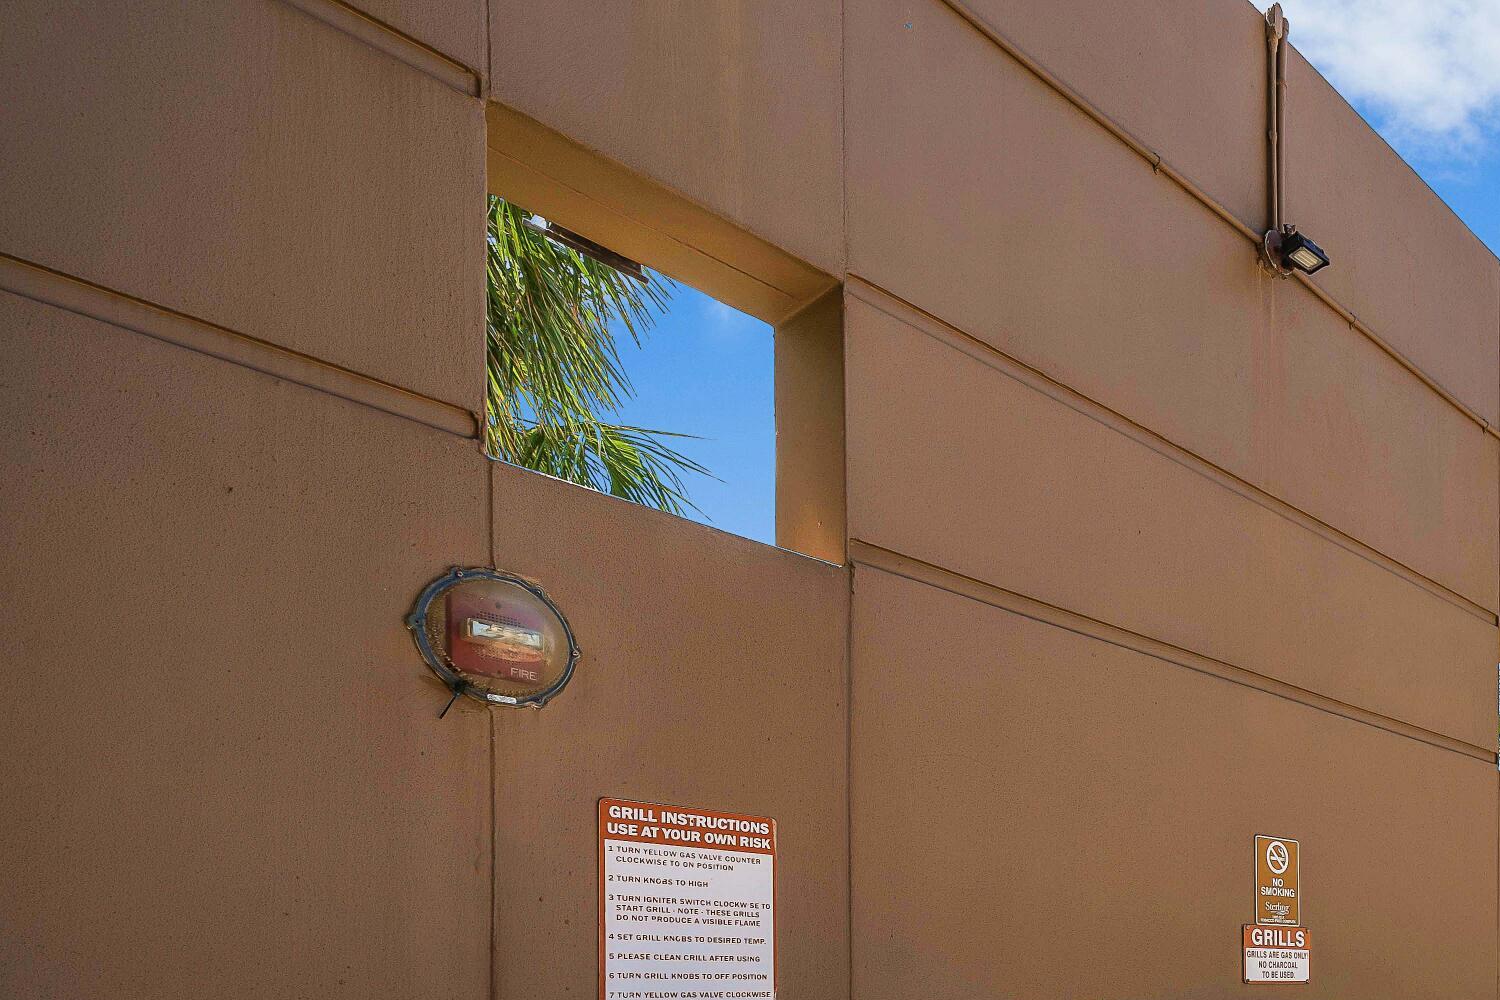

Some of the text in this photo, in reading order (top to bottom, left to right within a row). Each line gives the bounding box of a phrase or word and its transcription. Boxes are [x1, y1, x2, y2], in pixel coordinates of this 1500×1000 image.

[511, 668, 537, 681] FIRE
[609, 805, 769, 835] GRILL INSTRUCTIONS
[607, 822, 771, 849] USE AT YOUR OWN RISK
[643, 849, 676, 857] YELLOW
[698, 853, 722, 862] VALVE
[725, 856, 761, 864] COUNTER
[616, 856, 667, 866] CLOCKWISE
[697, 863, 733, 871] POSITION
[1272, 878, 1283, 887] NO
[1261, 887, 1295, 897] SMOKING
[1265, 901, 1290, 915] Sterling
[652, 916, 692, 924] PRODUCE
[1251, 929, 1305, 947] GRILLS
[1247, 951, 1267, 959] GRILLS
[1269, 951, 1280, 959] ARE
[1258, 961, 1267, 969] NO
[1262, 971, 1270, 979] TO
[1271, 971, 1278, 979] BE
